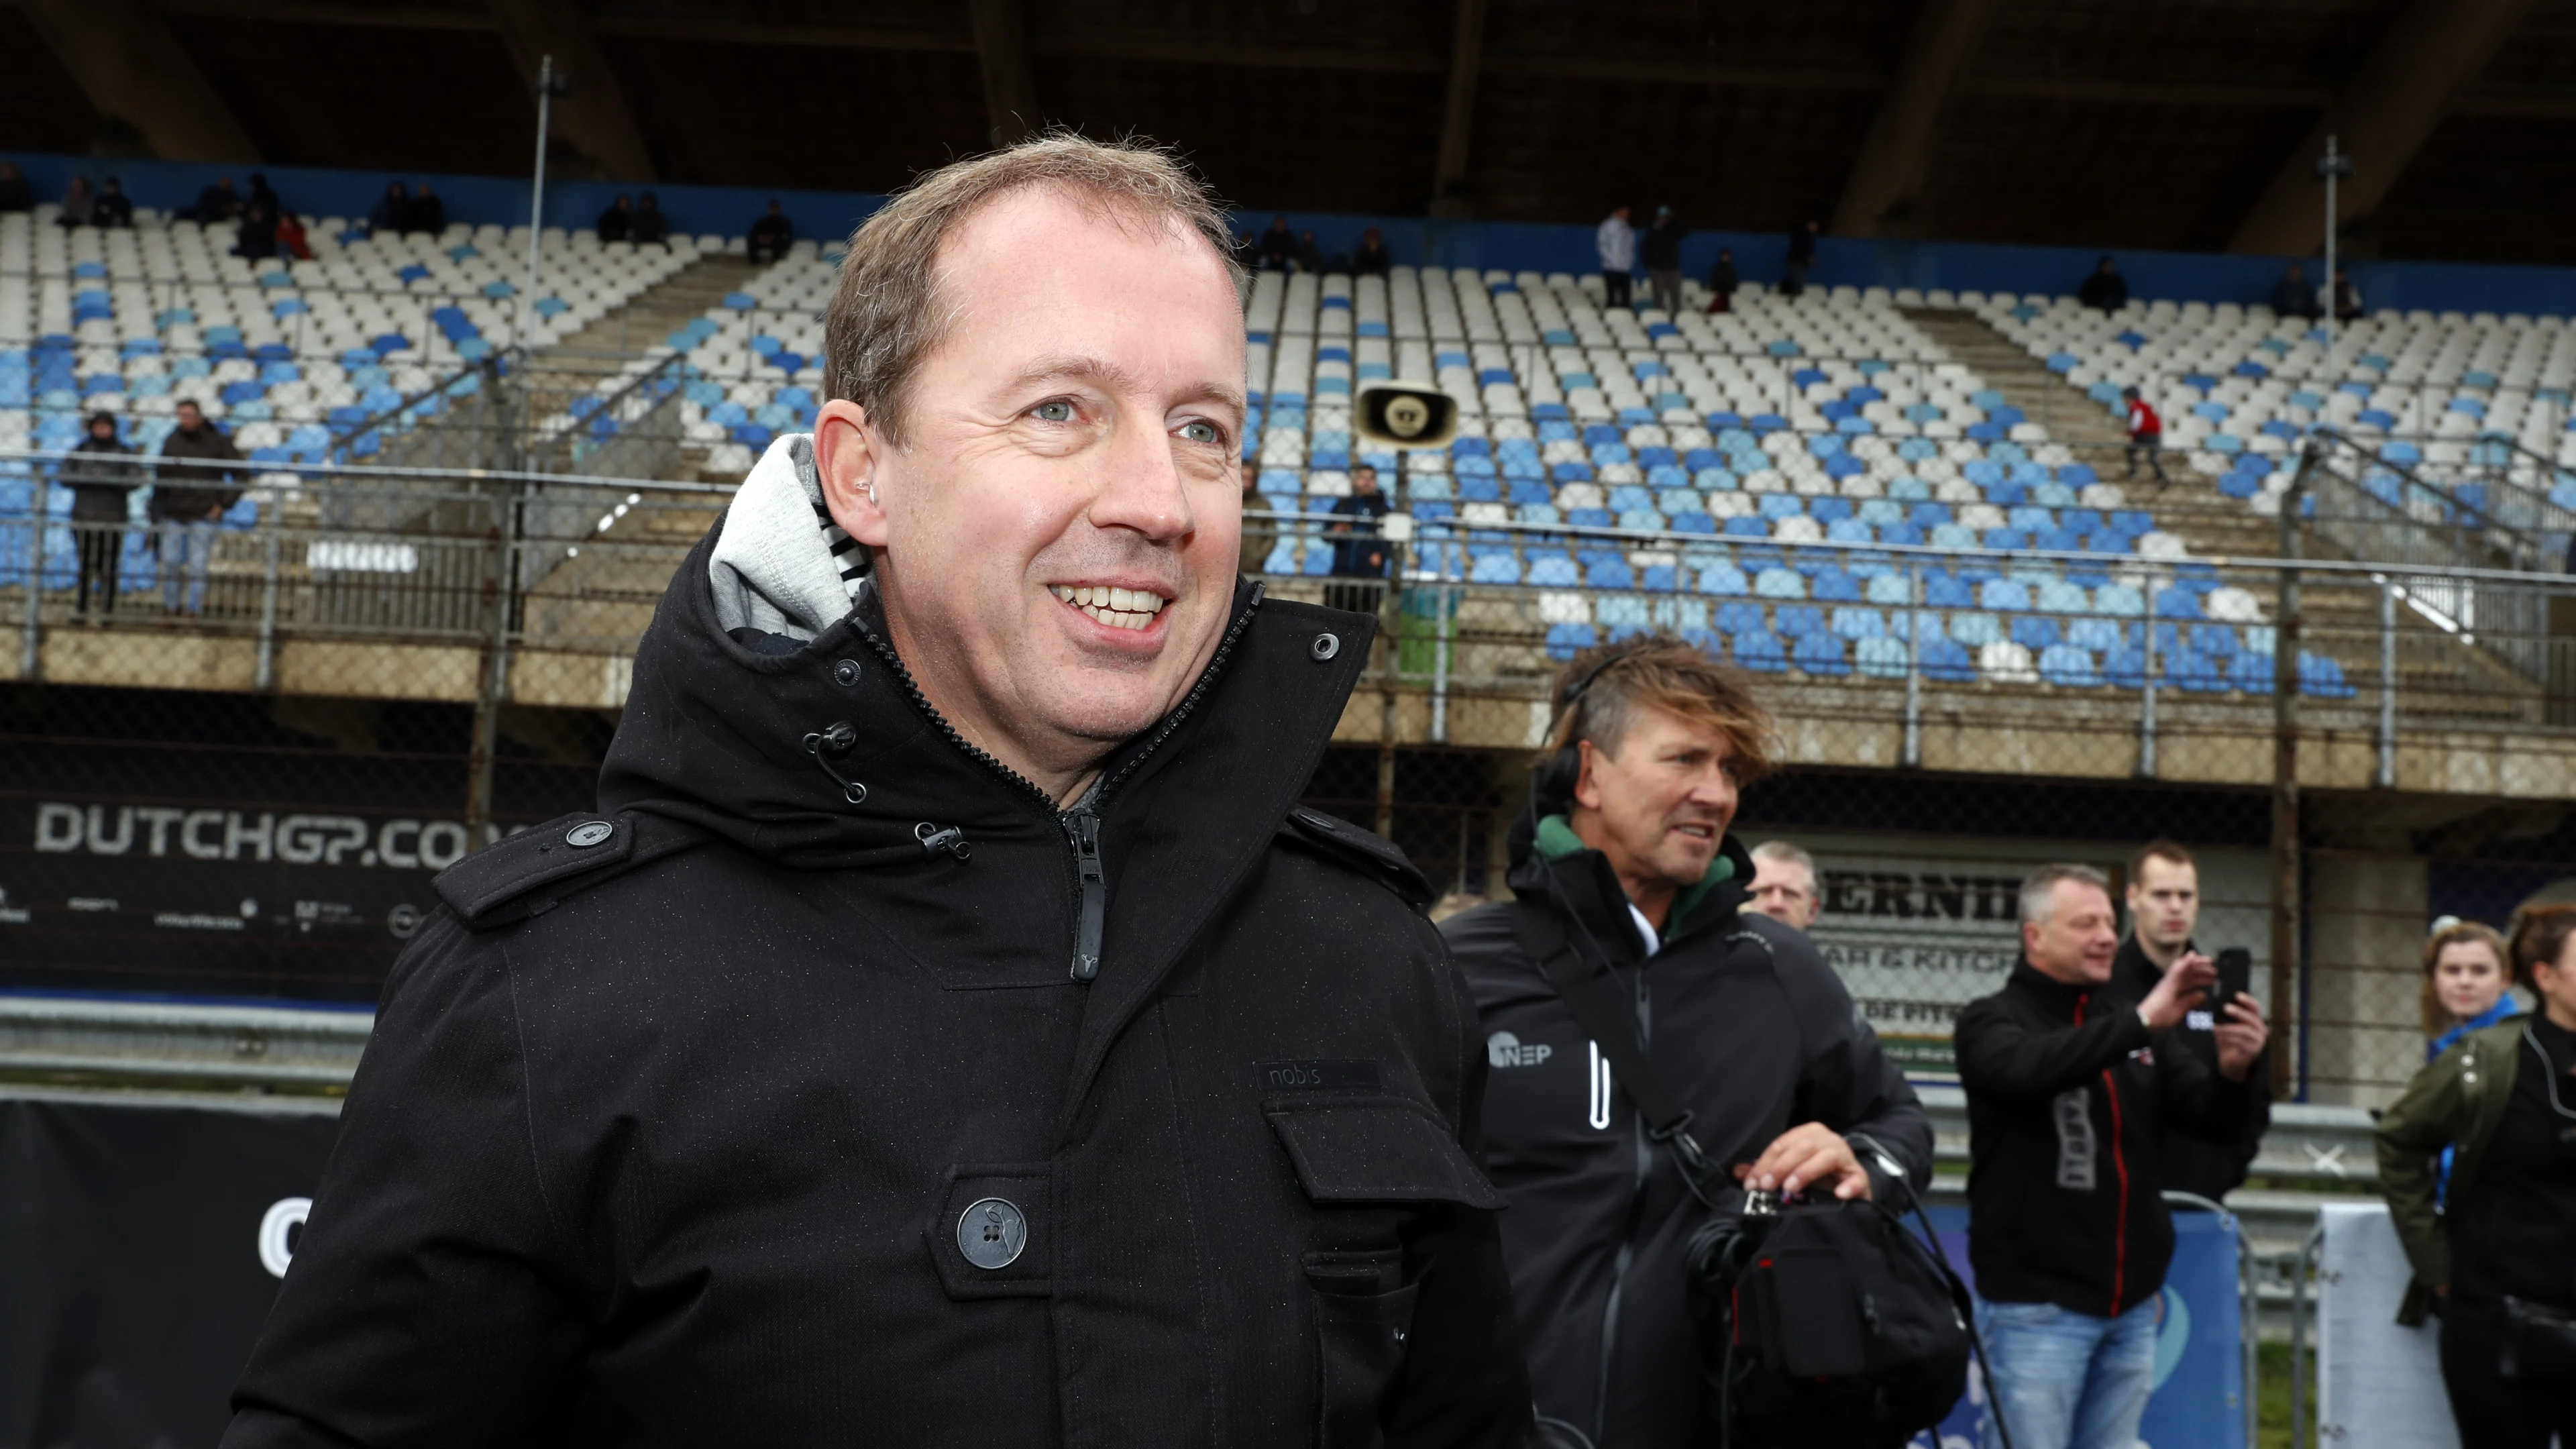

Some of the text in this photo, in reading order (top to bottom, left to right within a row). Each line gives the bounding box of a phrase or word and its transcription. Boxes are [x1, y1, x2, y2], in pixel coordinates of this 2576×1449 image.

[34, 802, 529, 870] DUTCHGP.CO
[1818, 869, 2021, 920] ERNI
[1914, 950, 2017, 973] KITCH
[1504, 1044, 1553, 1067] NEP
[1269, 1063, 1321, 1085] nobis
